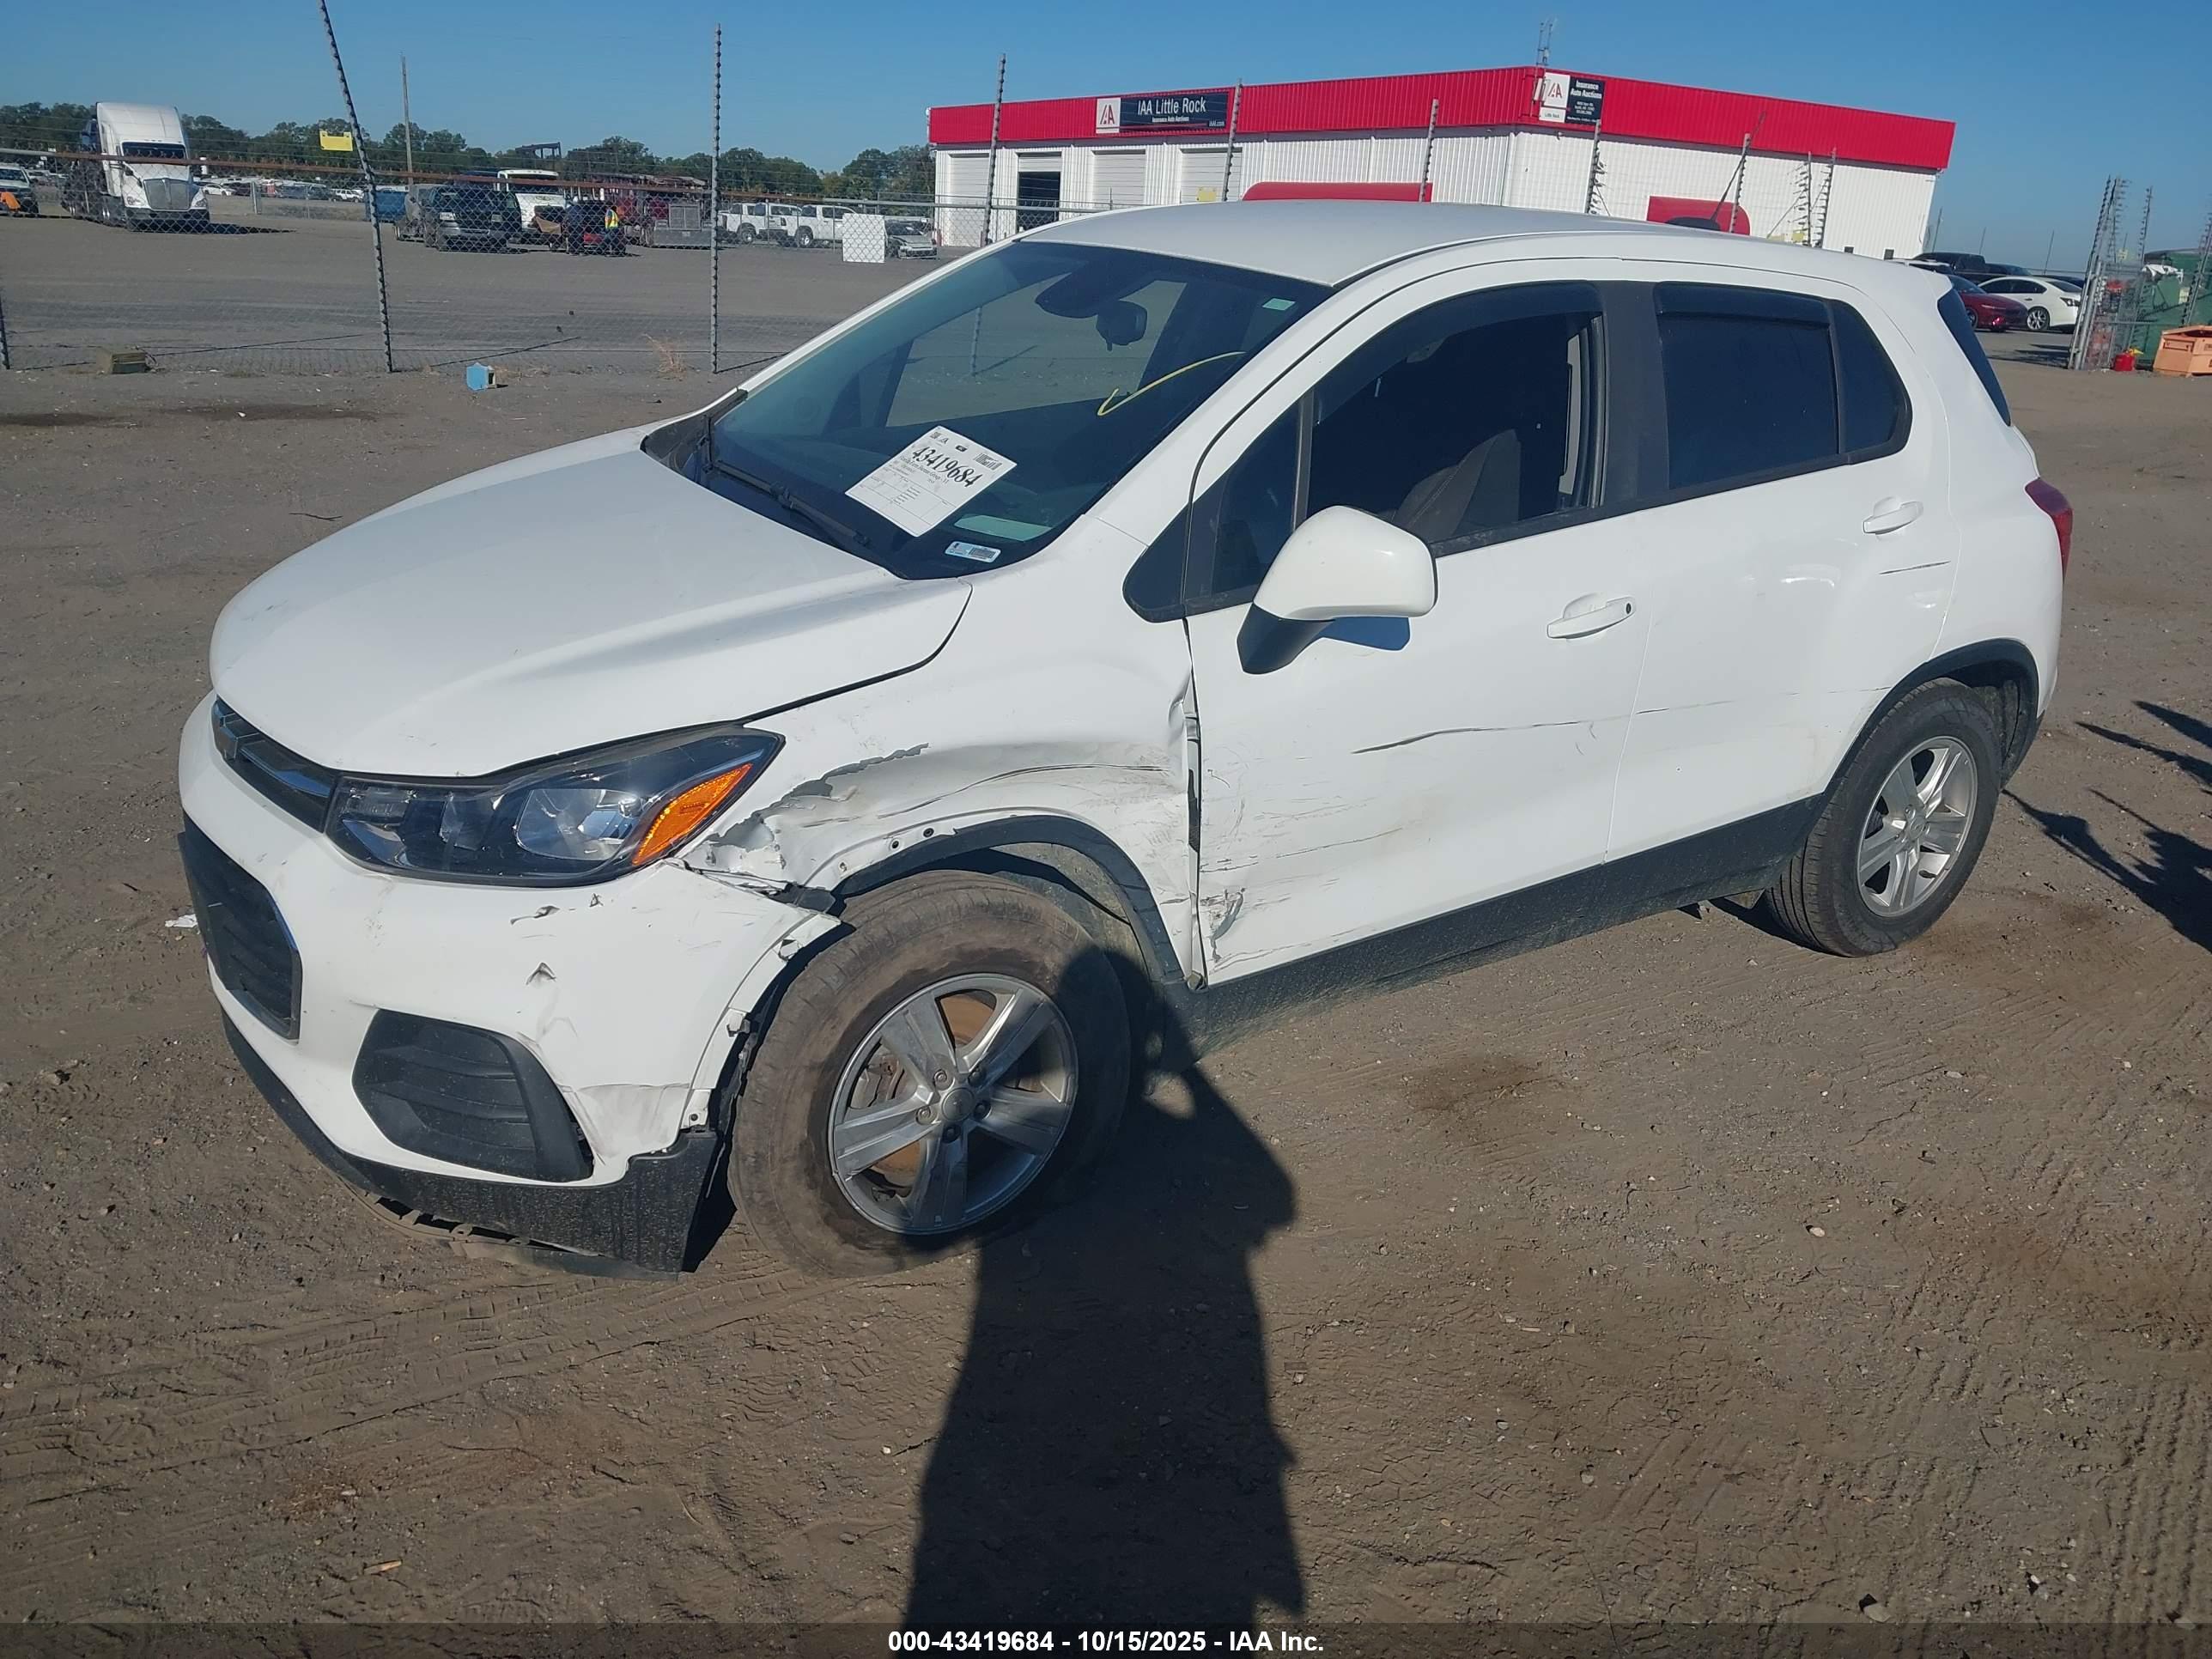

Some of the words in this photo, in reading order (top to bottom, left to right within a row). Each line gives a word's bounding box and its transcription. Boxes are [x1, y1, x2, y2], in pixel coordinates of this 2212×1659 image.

[1571, 88, 1582, 96] Auto
[1138, 100, 1153, 115] IAA
[1156, 97, 1179, 114] Little
[1182, 96, 1206, 113] Rock
[912, 447, 983, 488] 43419684
